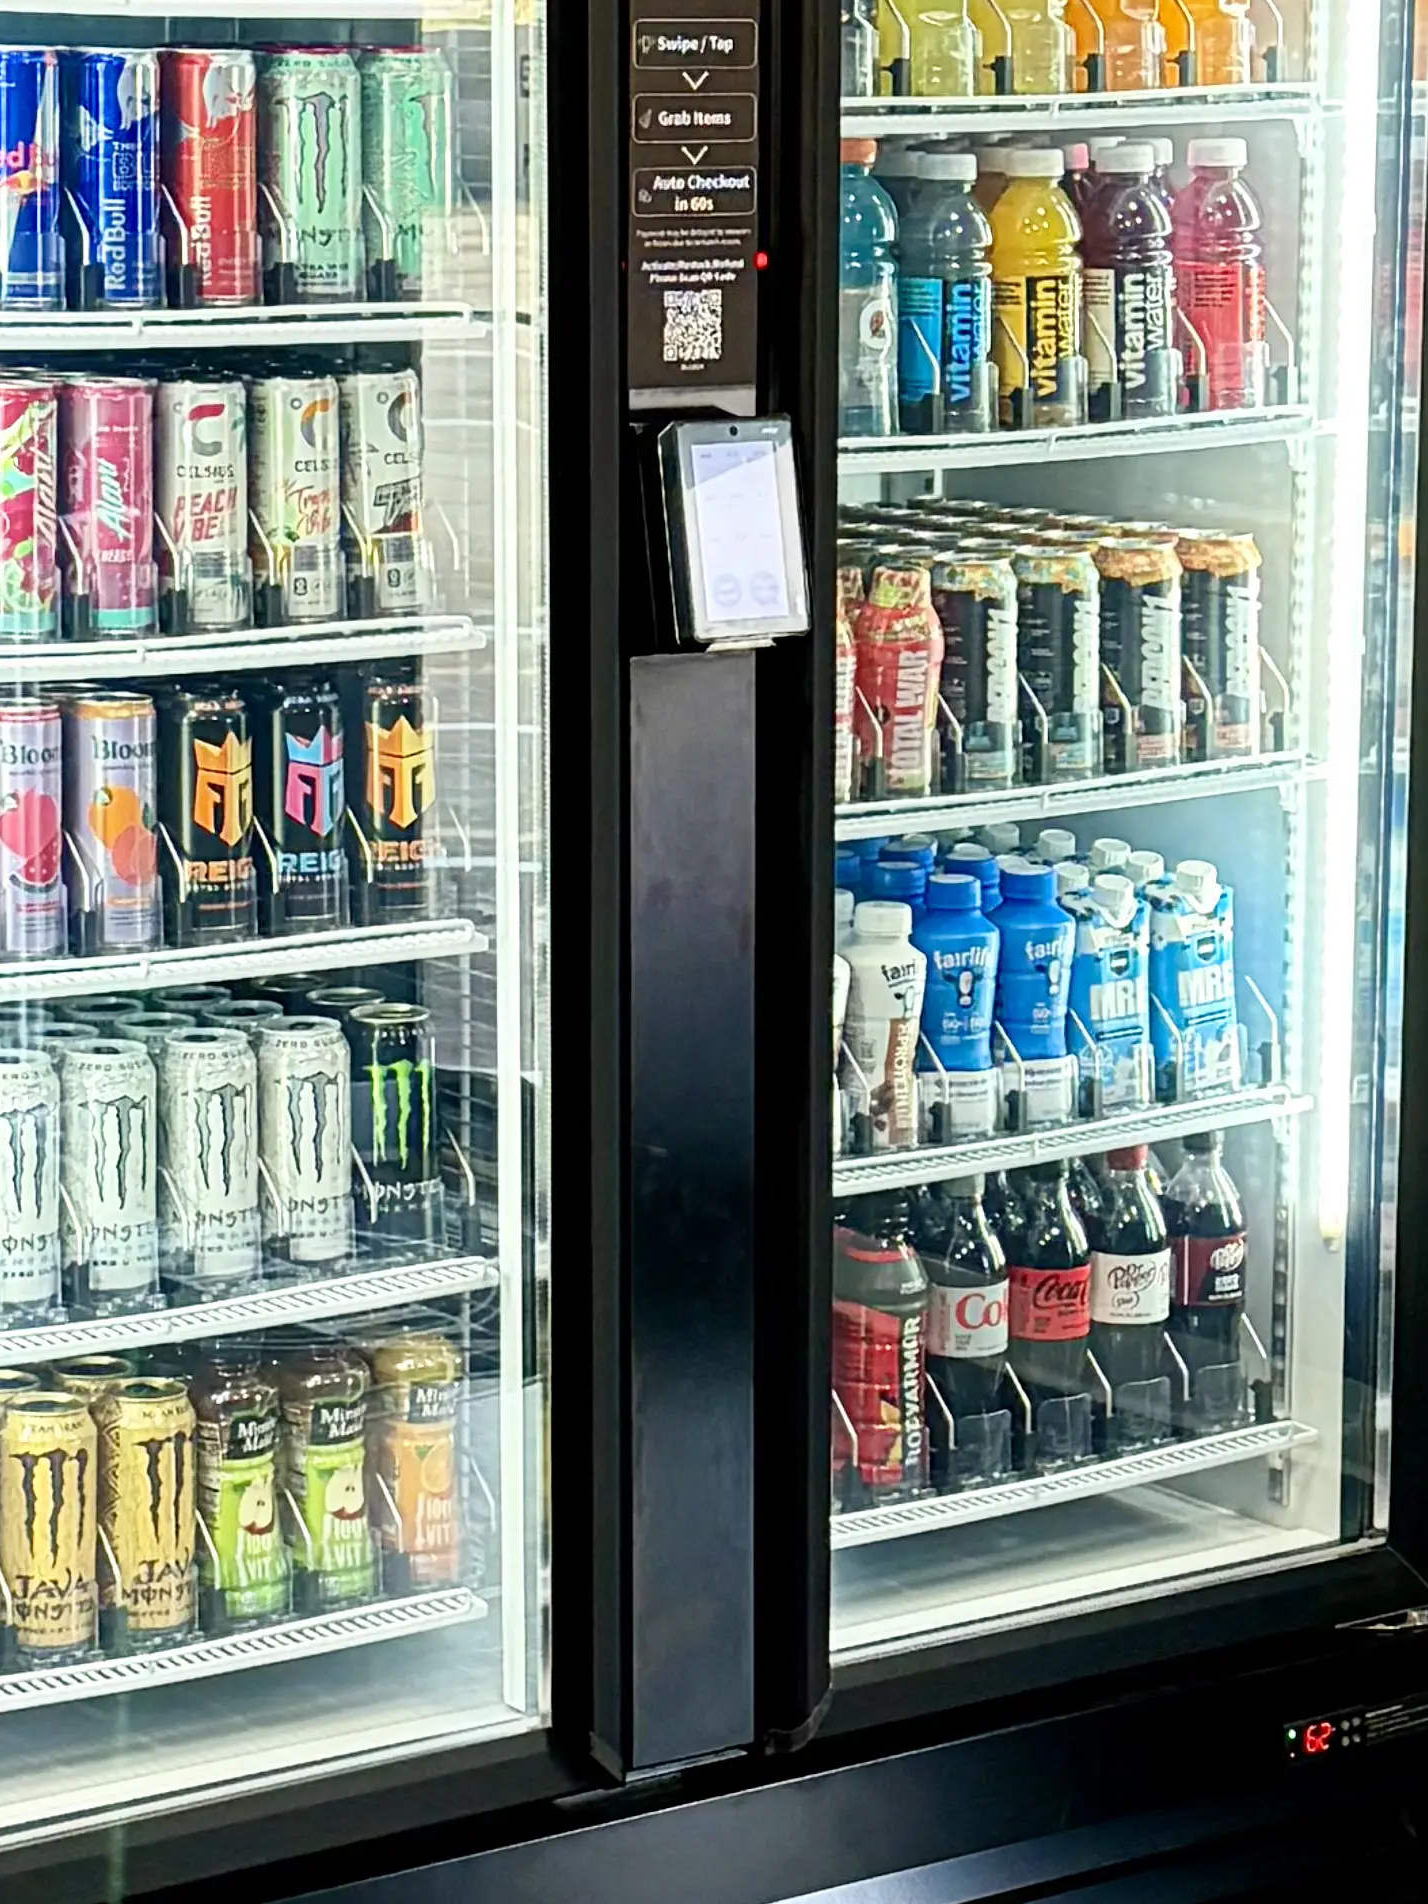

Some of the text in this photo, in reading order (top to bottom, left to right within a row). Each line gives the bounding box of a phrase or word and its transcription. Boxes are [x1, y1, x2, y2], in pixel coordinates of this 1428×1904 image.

[657, 36, 698, 54] Swipe
[709, 36, 733, 54] Tap
[658, 110, 731, 126] Grab Items
[653, 174, 750, 190] Auto Checkout
[101, 198, 126, 238] Bull
[675, 195, 714, 211] in 60s
[1146, 270, 1166, 351] water
[946, 282, 972, 403] vitamin
[1030, 278, 1057, 397] vitamin
[1119, 272, 1146, 390] vitamin
[174, 485, 238, 518] PEACH
[173, 516, 218, 543] VBE
